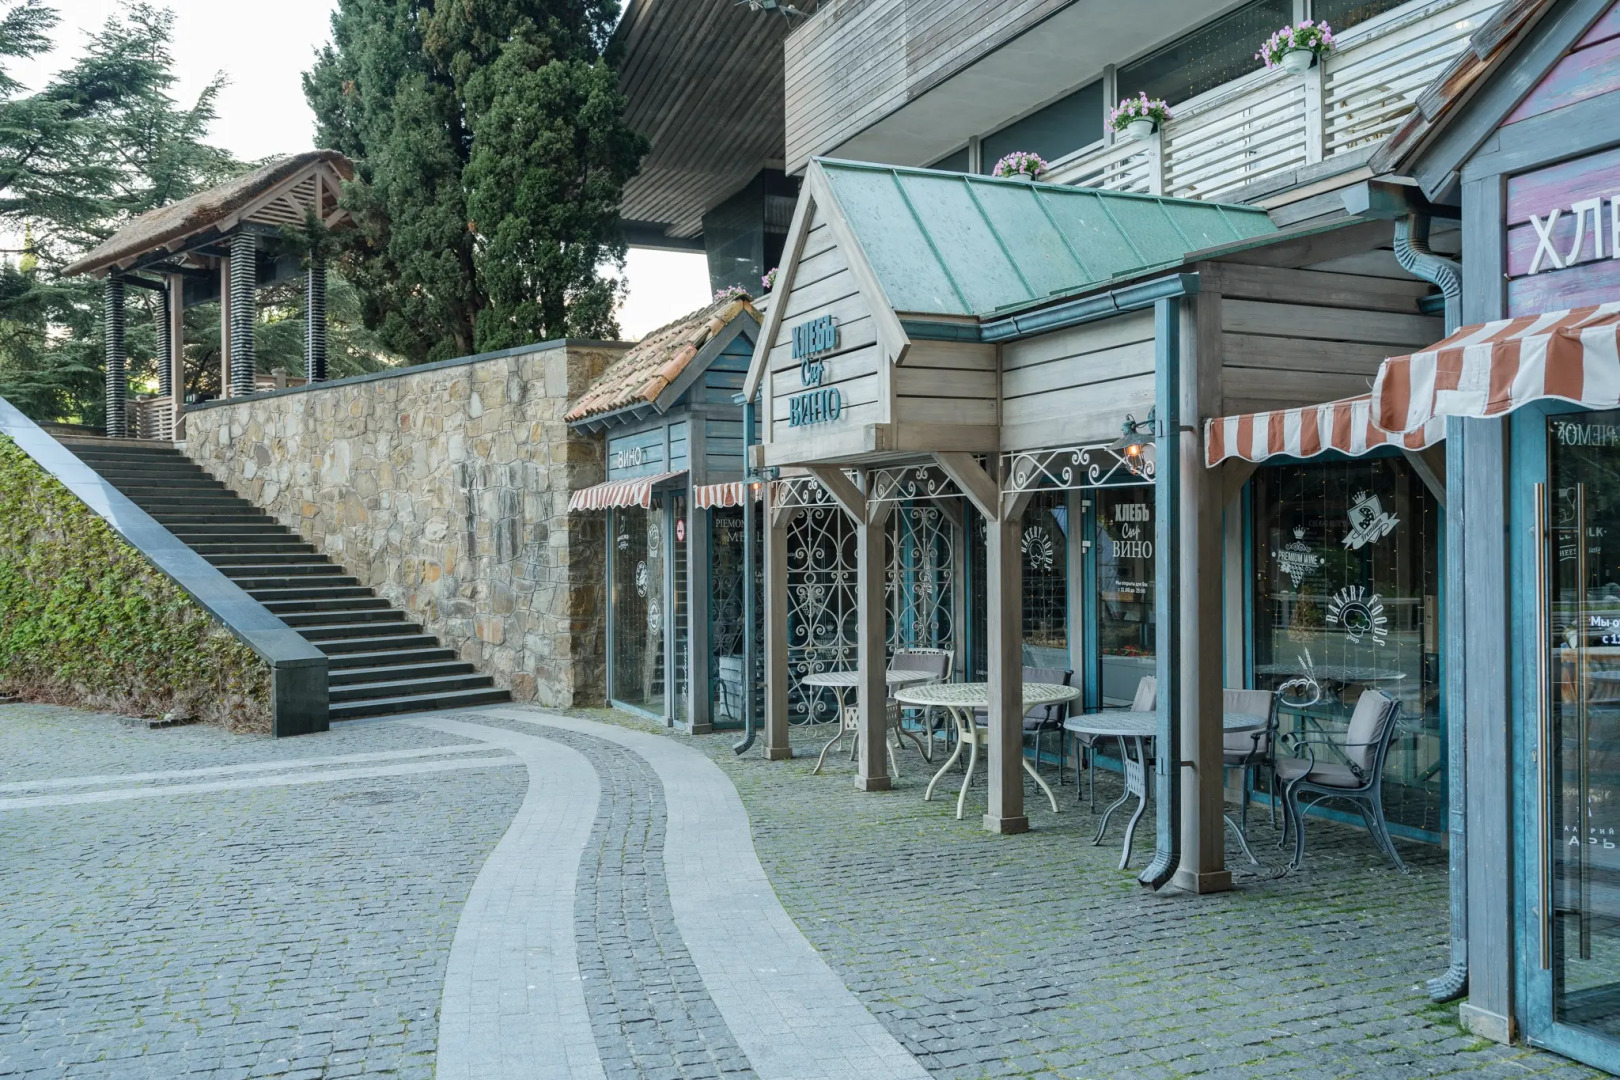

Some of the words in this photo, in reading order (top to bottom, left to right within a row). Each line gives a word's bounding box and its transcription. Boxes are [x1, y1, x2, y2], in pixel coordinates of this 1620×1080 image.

[792, 315, 837, 359] ХЛЕБЪ
[801, 356, 825, 388] Сыр
[788, 387, 842, 427] ВИНО
[618, 446, 642, 468] ВИНО
[1115, 503, 1150, 521] ХЛЕБЪ
[1122, 522, 1141, 540] Сыр
[1112, 540, 1153, 559] ВИНО
[1277, 550, 1303, 563] PREMIUM
[1303, 554, 1319, 565] WINE
[1326, 585, 1365, 624] BAKERY
[1366, 594, 1388, 646] FOODS
[1590, 615, 1610, 627] Мы
[1602, 635, 1609, 644] с
